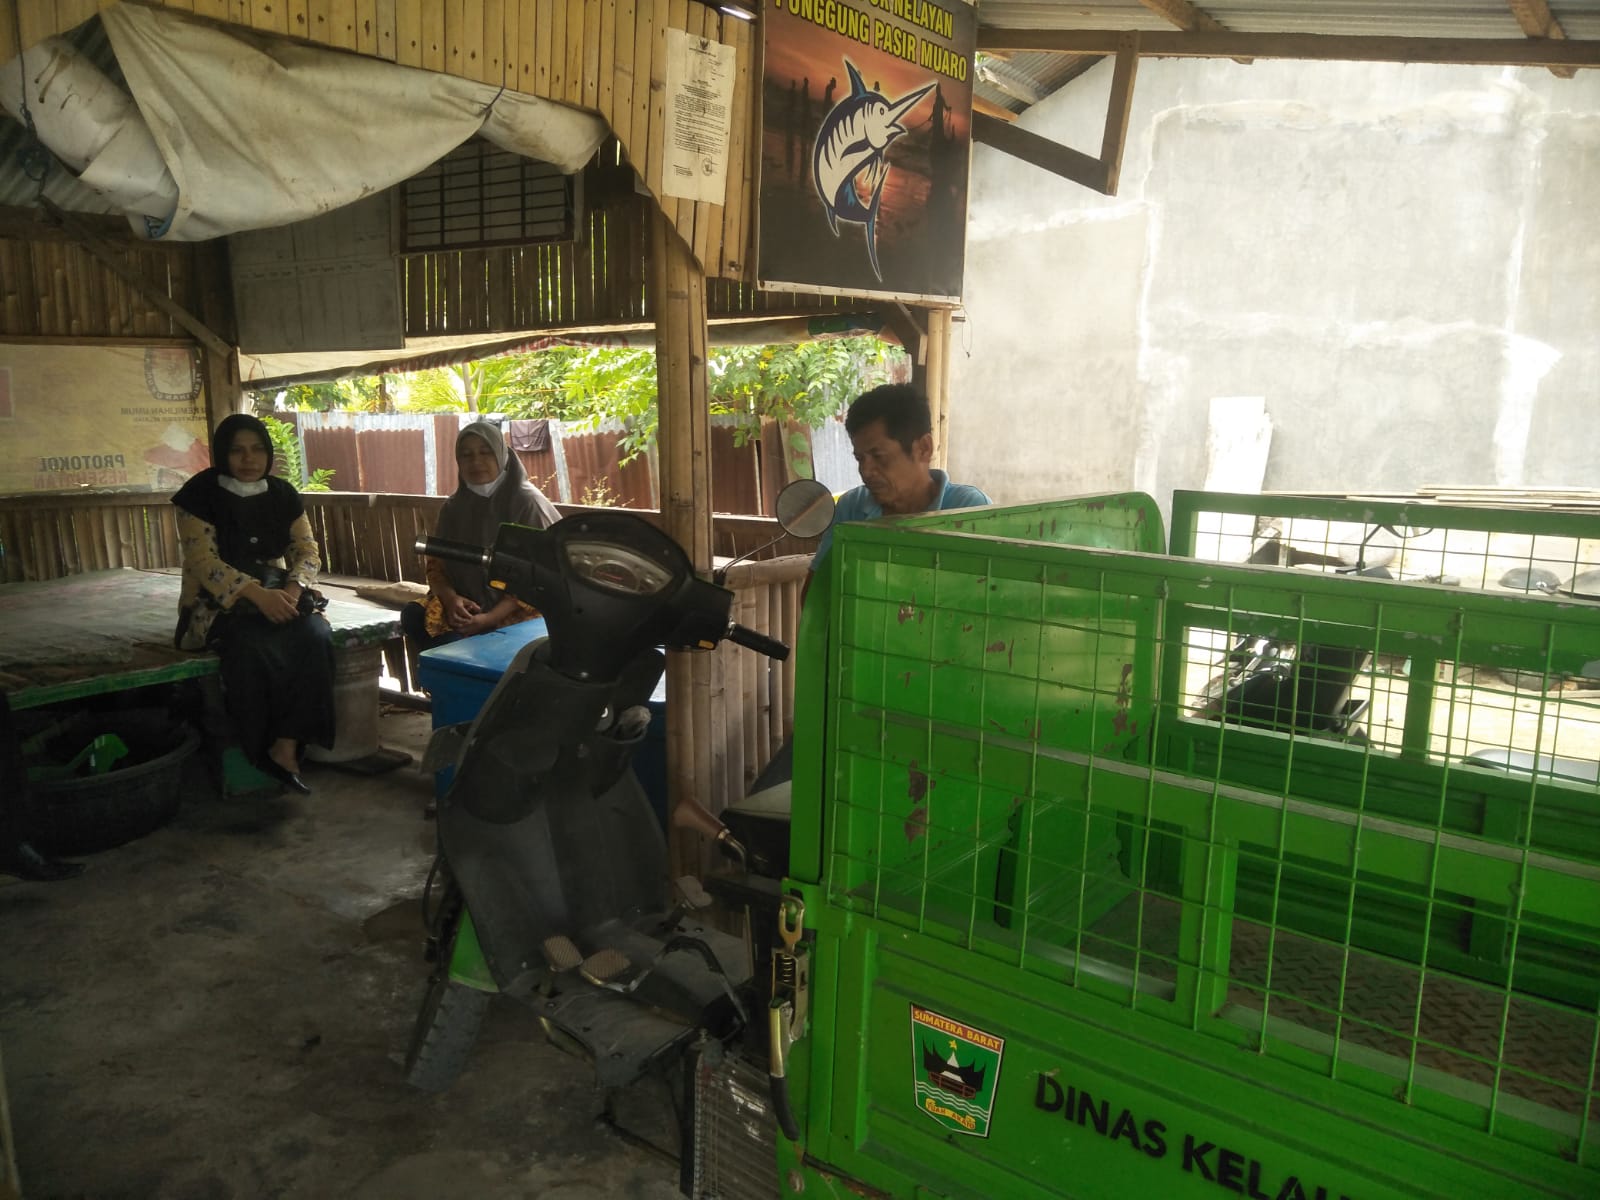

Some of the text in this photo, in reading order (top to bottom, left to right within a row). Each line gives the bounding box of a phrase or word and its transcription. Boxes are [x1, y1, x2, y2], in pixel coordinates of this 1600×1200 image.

[775, 0, 967, 82] UNGGUNG PASIR MUARO
[893, 0, 953, 39] NELAYAN
[914, 1010, 1000, 1050] SUMATERA BARAT
[1034, 1072, 1352, 1200] DINAS KELA
